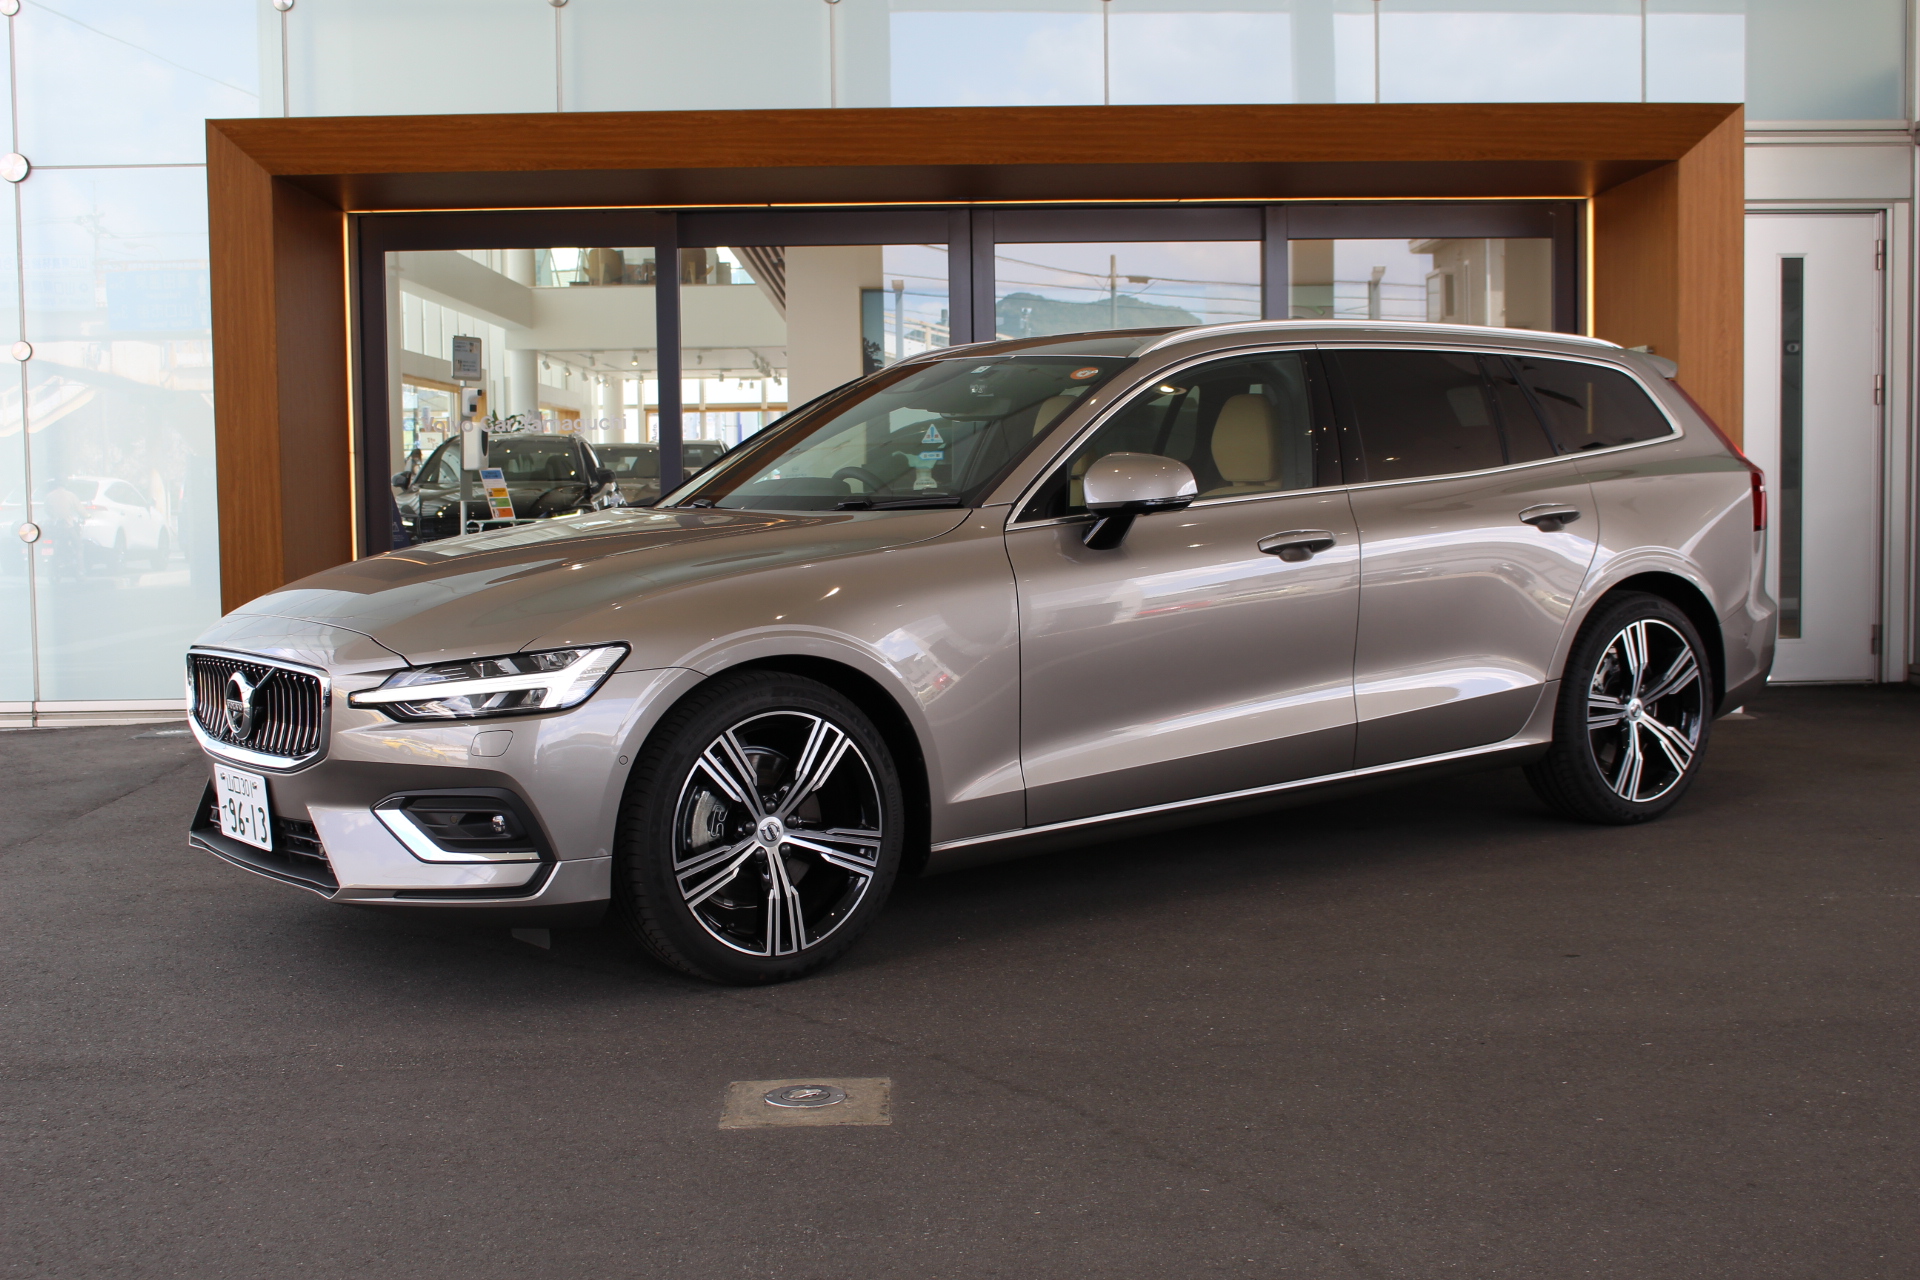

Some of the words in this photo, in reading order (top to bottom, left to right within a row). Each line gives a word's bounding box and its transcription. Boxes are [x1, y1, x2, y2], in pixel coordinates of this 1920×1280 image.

[421, 416, 473, 432] Volvo
[480, 415, 514, 432] Car
[520, 413, 627, 434] Yamaguchi
[229, 798, 267, 843] 96-13
